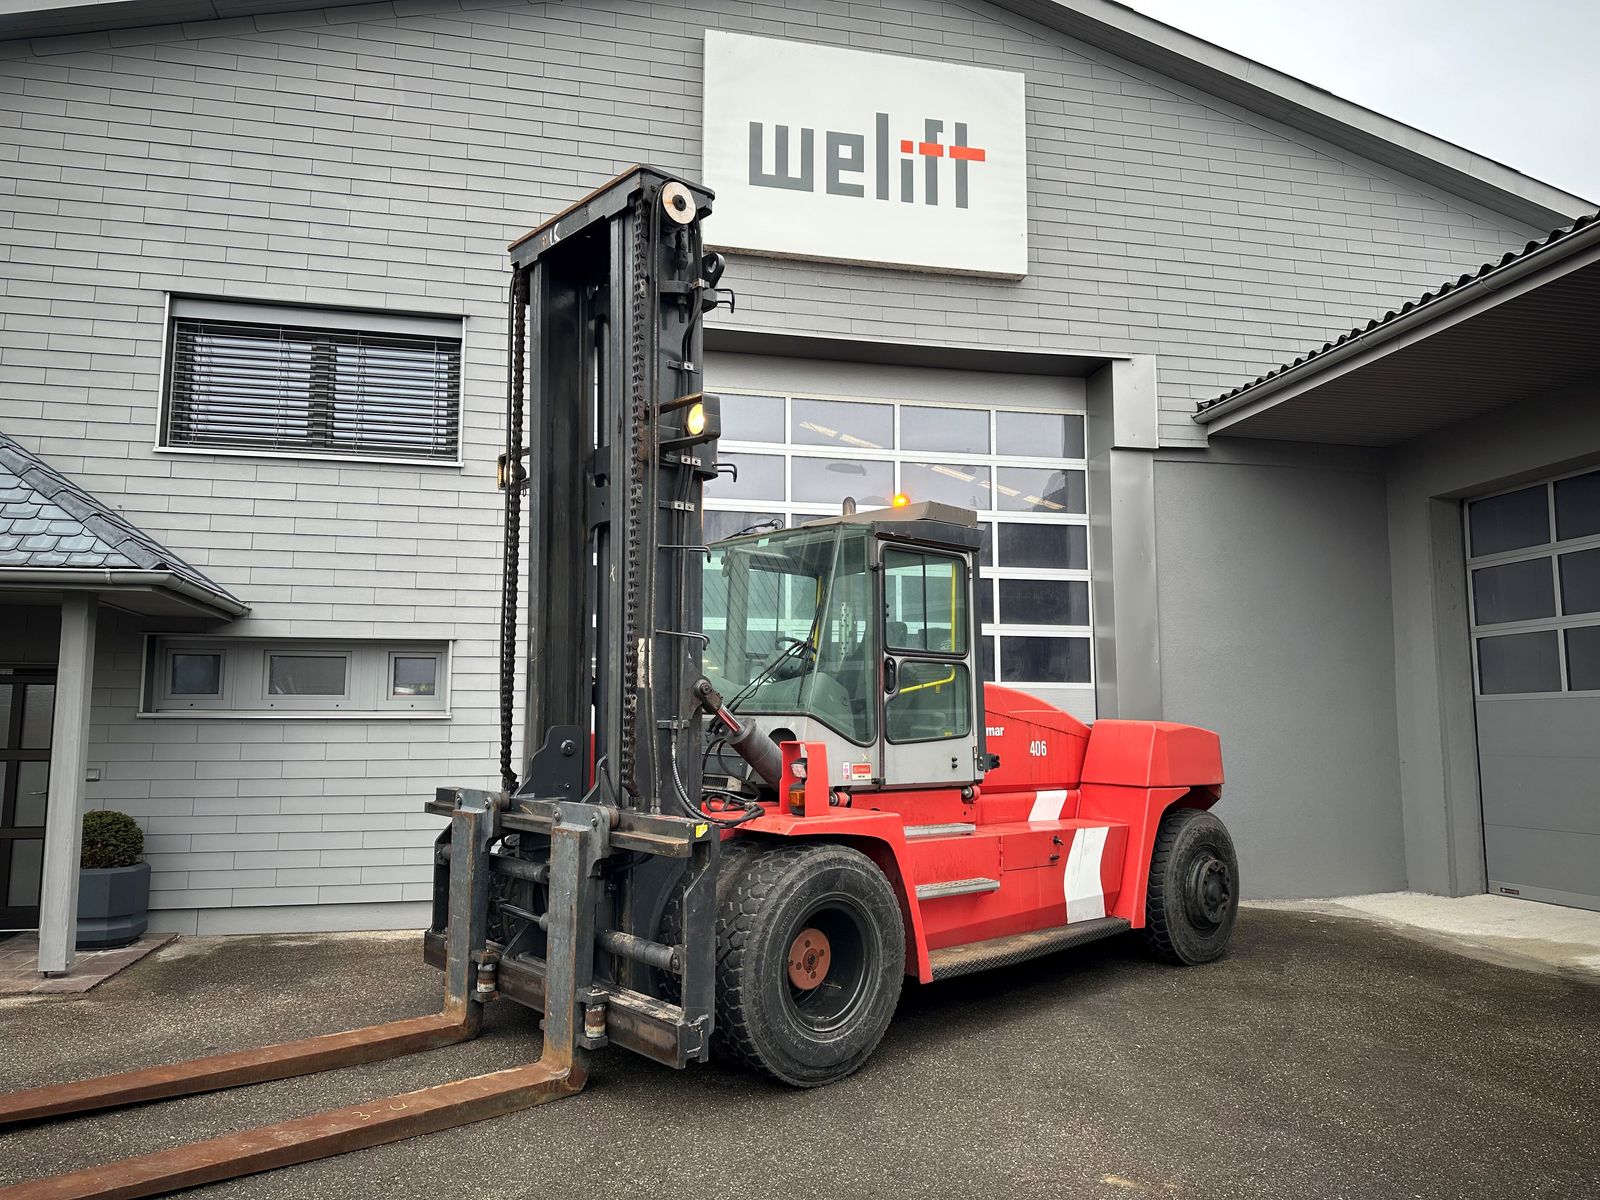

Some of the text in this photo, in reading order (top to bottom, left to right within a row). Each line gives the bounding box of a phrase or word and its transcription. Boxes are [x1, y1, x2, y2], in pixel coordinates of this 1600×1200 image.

[749, 112, 986, 209] welift
[985, 726, 1005, 737] mar
[1029, 740, 1047, 757] 406
